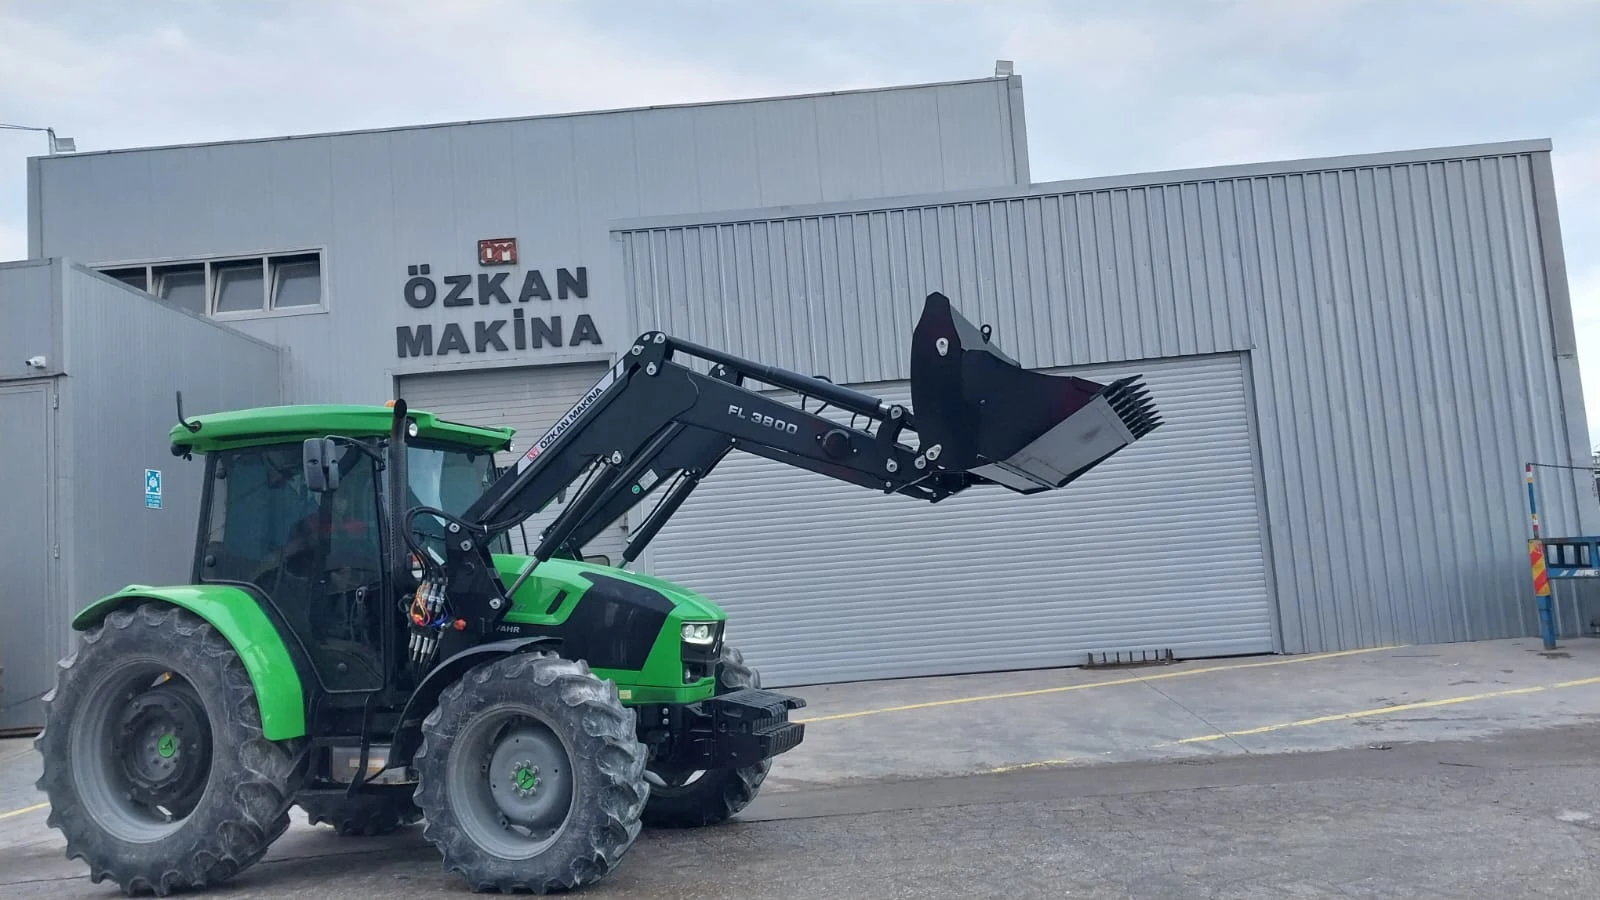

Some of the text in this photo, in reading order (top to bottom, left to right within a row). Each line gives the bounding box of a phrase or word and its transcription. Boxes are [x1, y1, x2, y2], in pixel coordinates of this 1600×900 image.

[404, 264, 588, 309] ÖZKAN
[396, 308, 603, 358] MAKİNA
[728, 404, 798, 434] FL 3800
